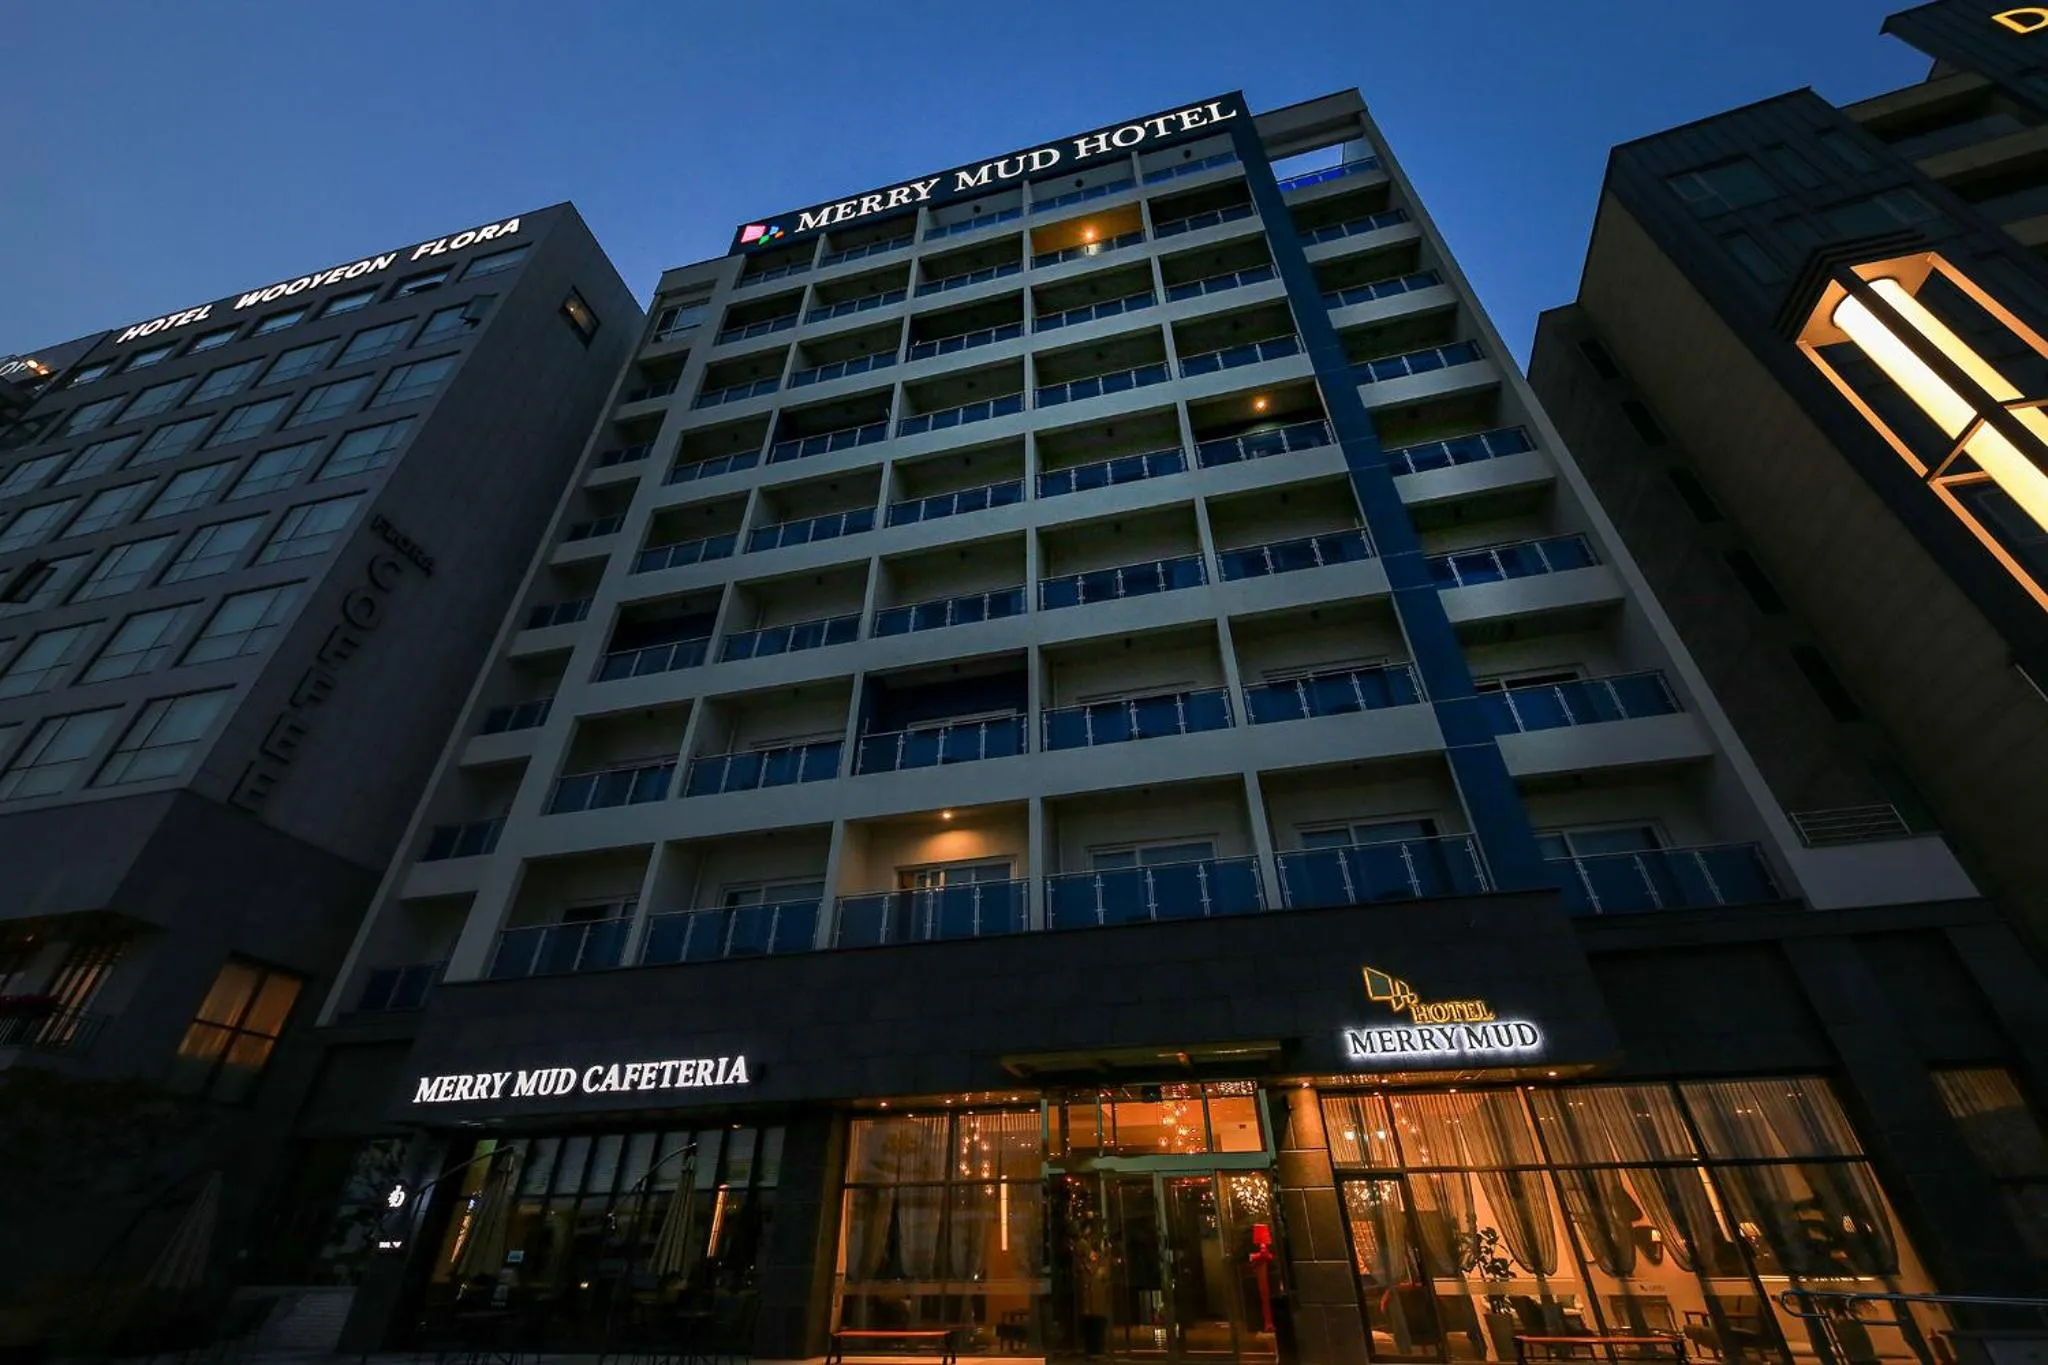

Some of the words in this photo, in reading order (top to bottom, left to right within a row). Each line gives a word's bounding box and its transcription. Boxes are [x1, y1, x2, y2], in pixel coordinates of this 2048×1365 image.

[794, 177, 942, 233] MERRY
[953, 148, 1062, 193] MUD
[1073, 101, 1238, 160] HOTEL
[116, 304, 213, 343] HOTEL
[233, 253, 398, 310] WOOYEON
[411, 218, 521, 261] FLORA
[1410, 1000, 1496, 1024] HOTEL
[1349, 1026, 1457, 1056] MERRY
[1463, 1021, 1540, 1049] MUD
[412, 1072, 512, 1103] MERRY
[512, 1068, 577, 1097] MUD
[582, 1055, 750, 1093] CAFETERIA
